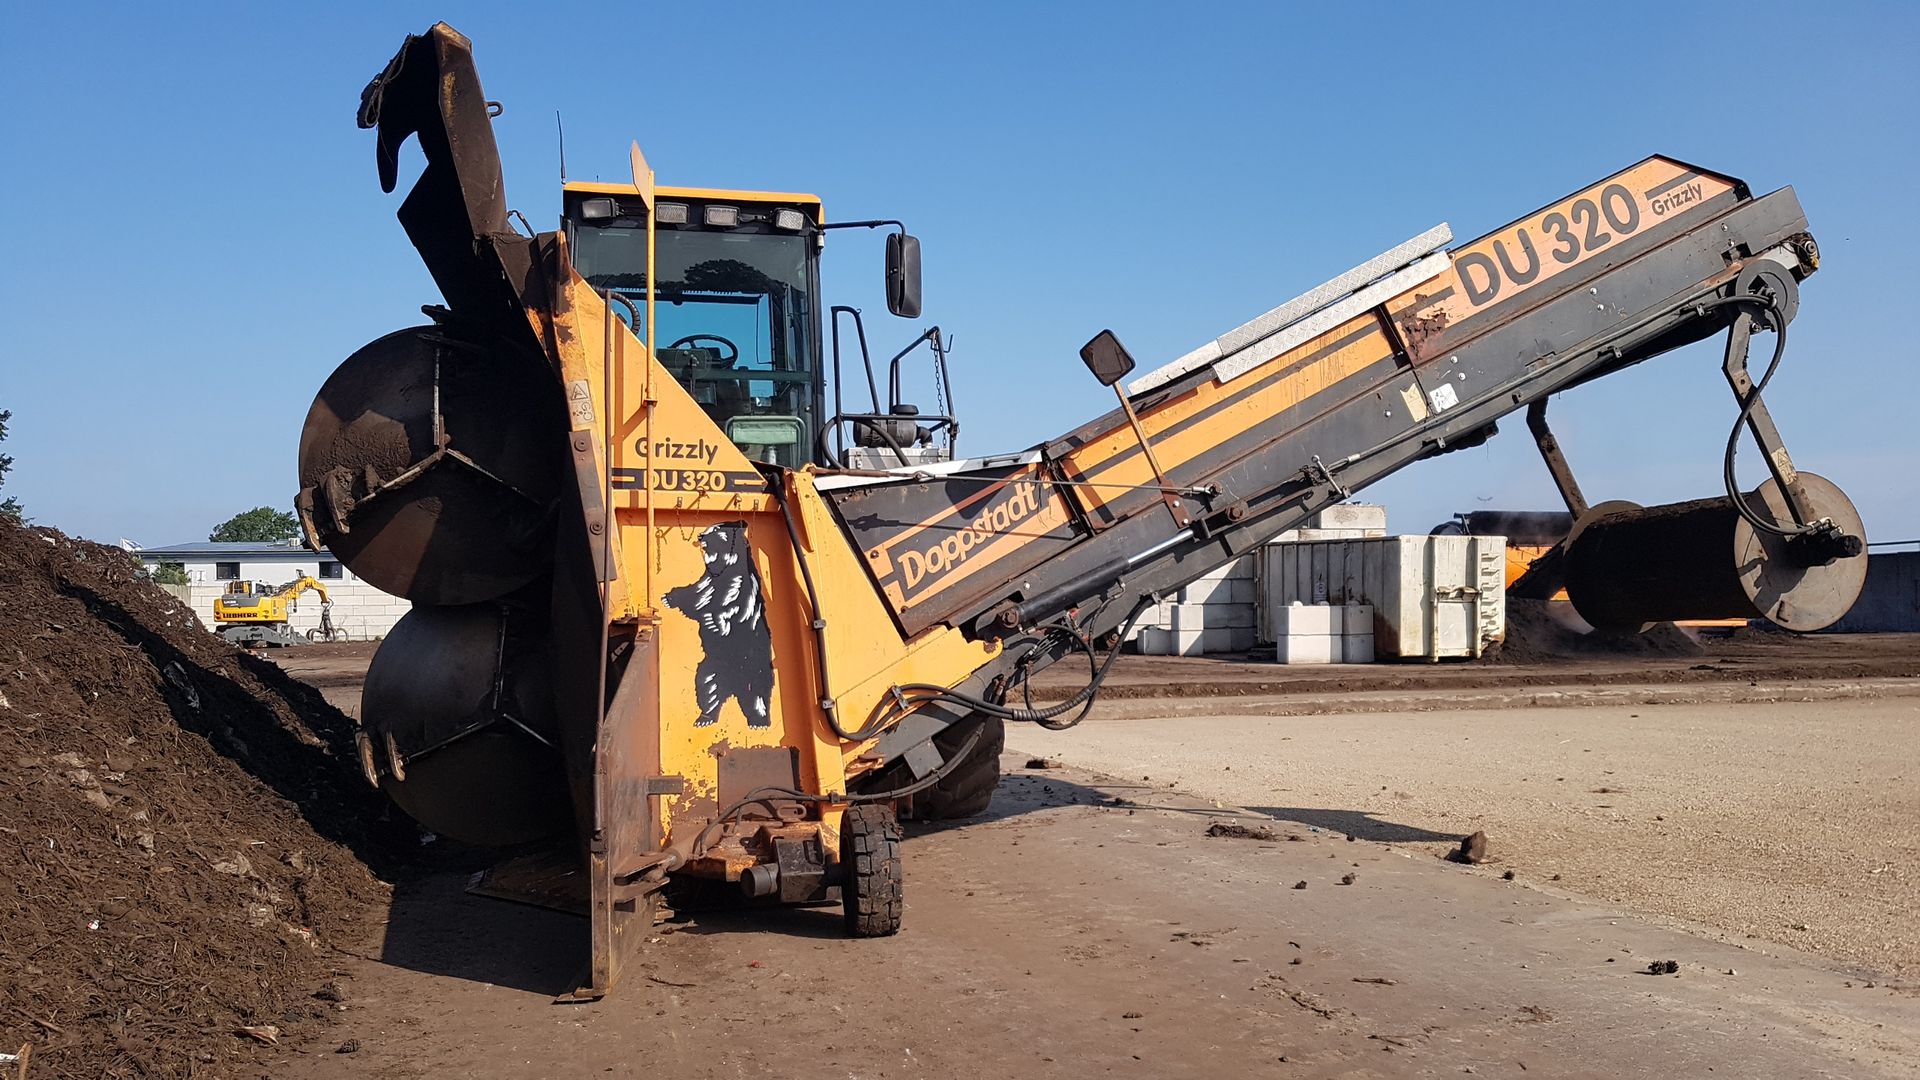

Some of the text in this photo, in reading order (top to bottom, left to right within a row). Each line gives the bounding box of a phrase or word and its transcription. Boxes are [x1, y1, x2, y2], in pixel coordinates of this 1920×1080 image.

[1651, 182, 1703, 216] Grizzly
[1455, 184, 1640, 306] DU 320
[635, 437, 718, 465] Grizzly
[643, 470, 726, 491] DU 320
[897, 479, 1038, 590] Doppstadt
